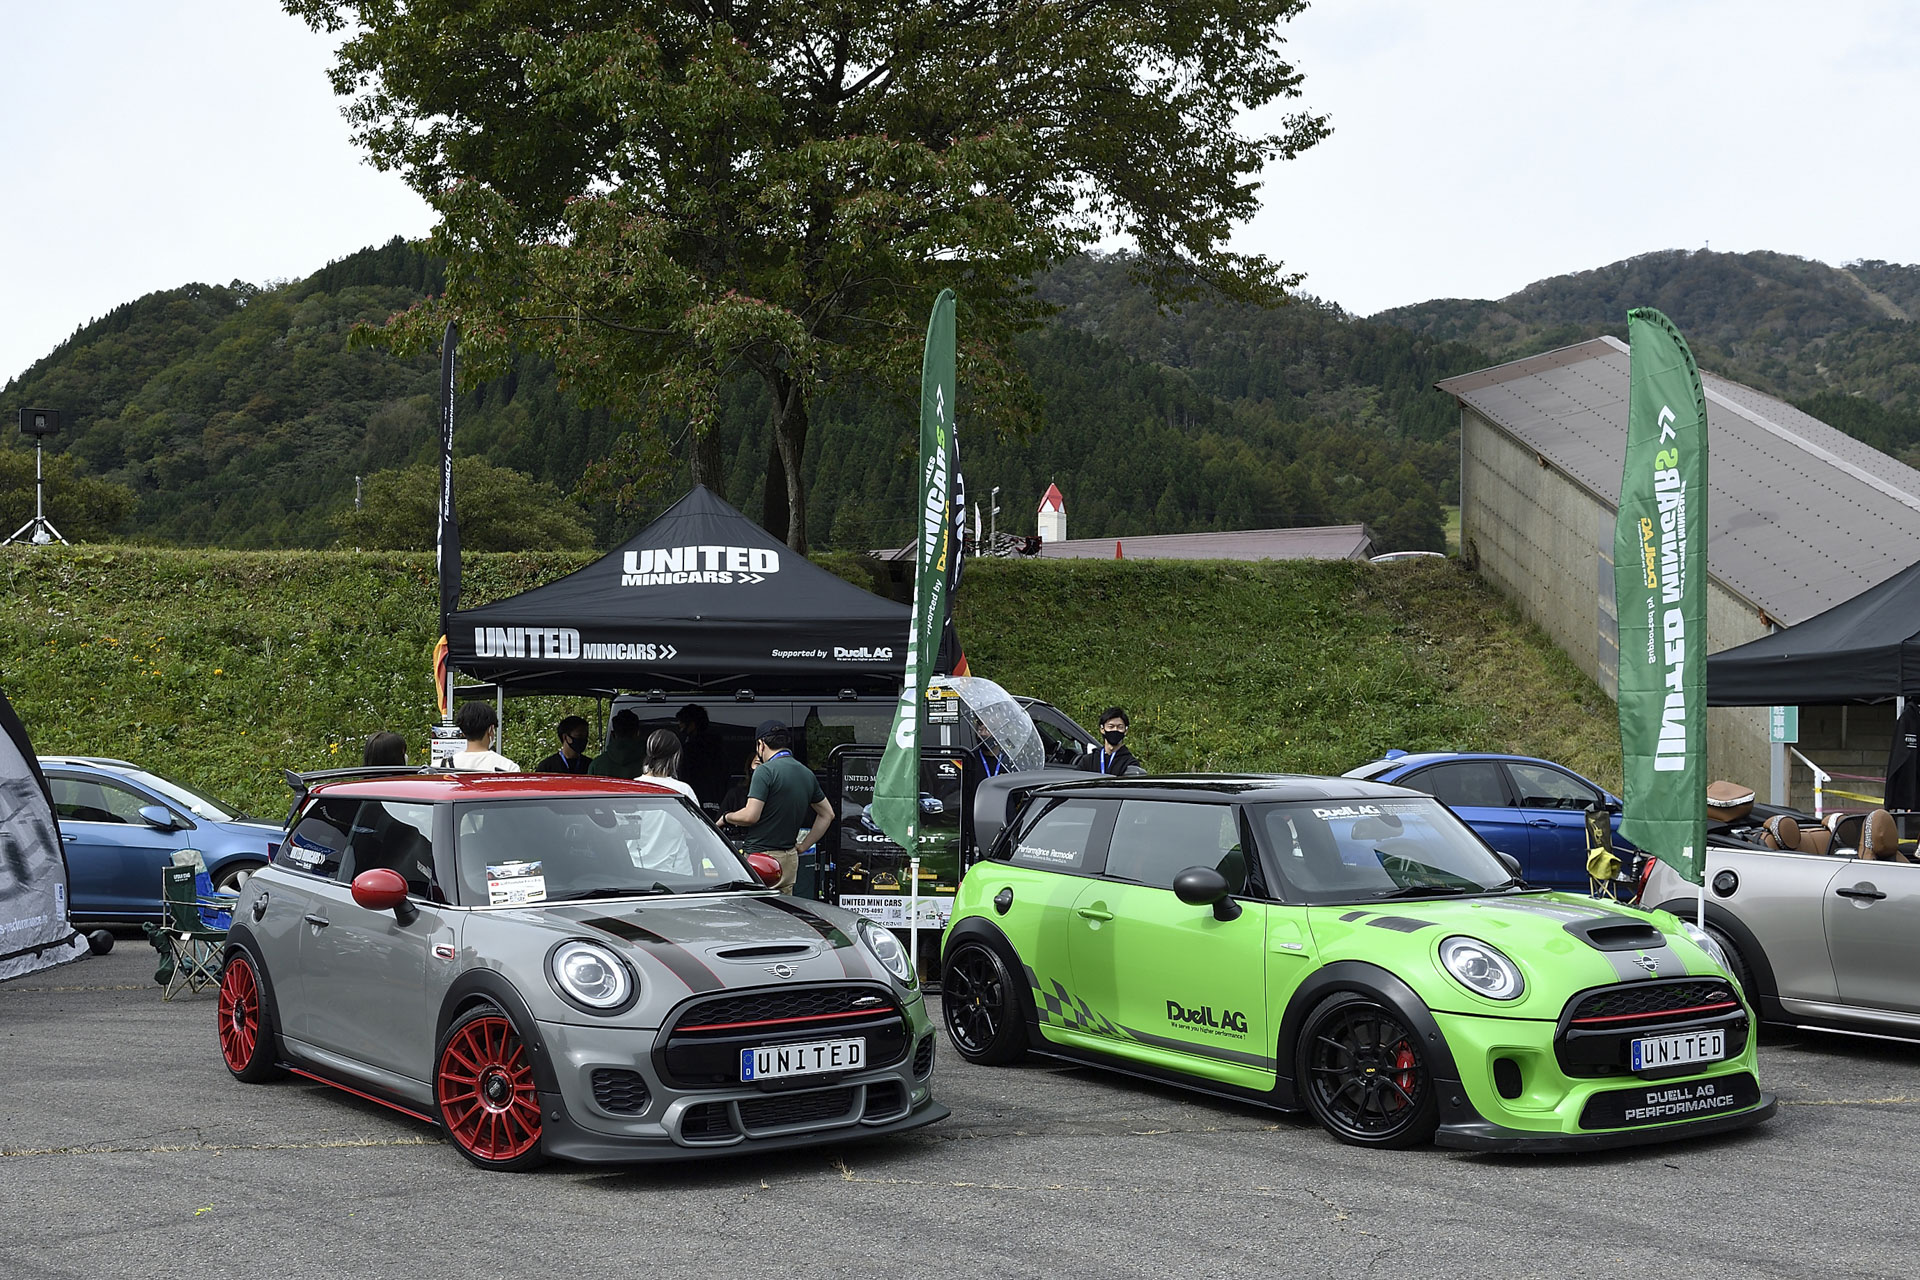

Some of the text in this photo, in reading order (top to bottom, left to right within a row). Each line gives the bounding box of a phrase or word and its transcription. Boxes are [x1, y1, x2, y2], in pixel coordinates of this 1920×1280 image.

[623, 545, 780, 575] UNITED
[621, 571, 733, 587] MINICARS
[474, 627, 657, 660] UNITED MINICARS
[771, 649, 816, 659] Supported
[816, 649, 828, 659] by
[872, 646, 893, 658] AG
[841, 898, 903, 907] UNITED MINI CARS
[1200, 1027, 1214, 1035] higher
[1215, 1030, 1243, 1040] performance
[1220, 1010, 1249, 1034] AG
[758, 1044, 860, 1074] UNITED
[1644, 1035, 1721, 1064] UNITED
[1646, 1084, 1715, 1105] DUELL AG
[1625, 1094, 1734, 1121] PERFORMANCE
